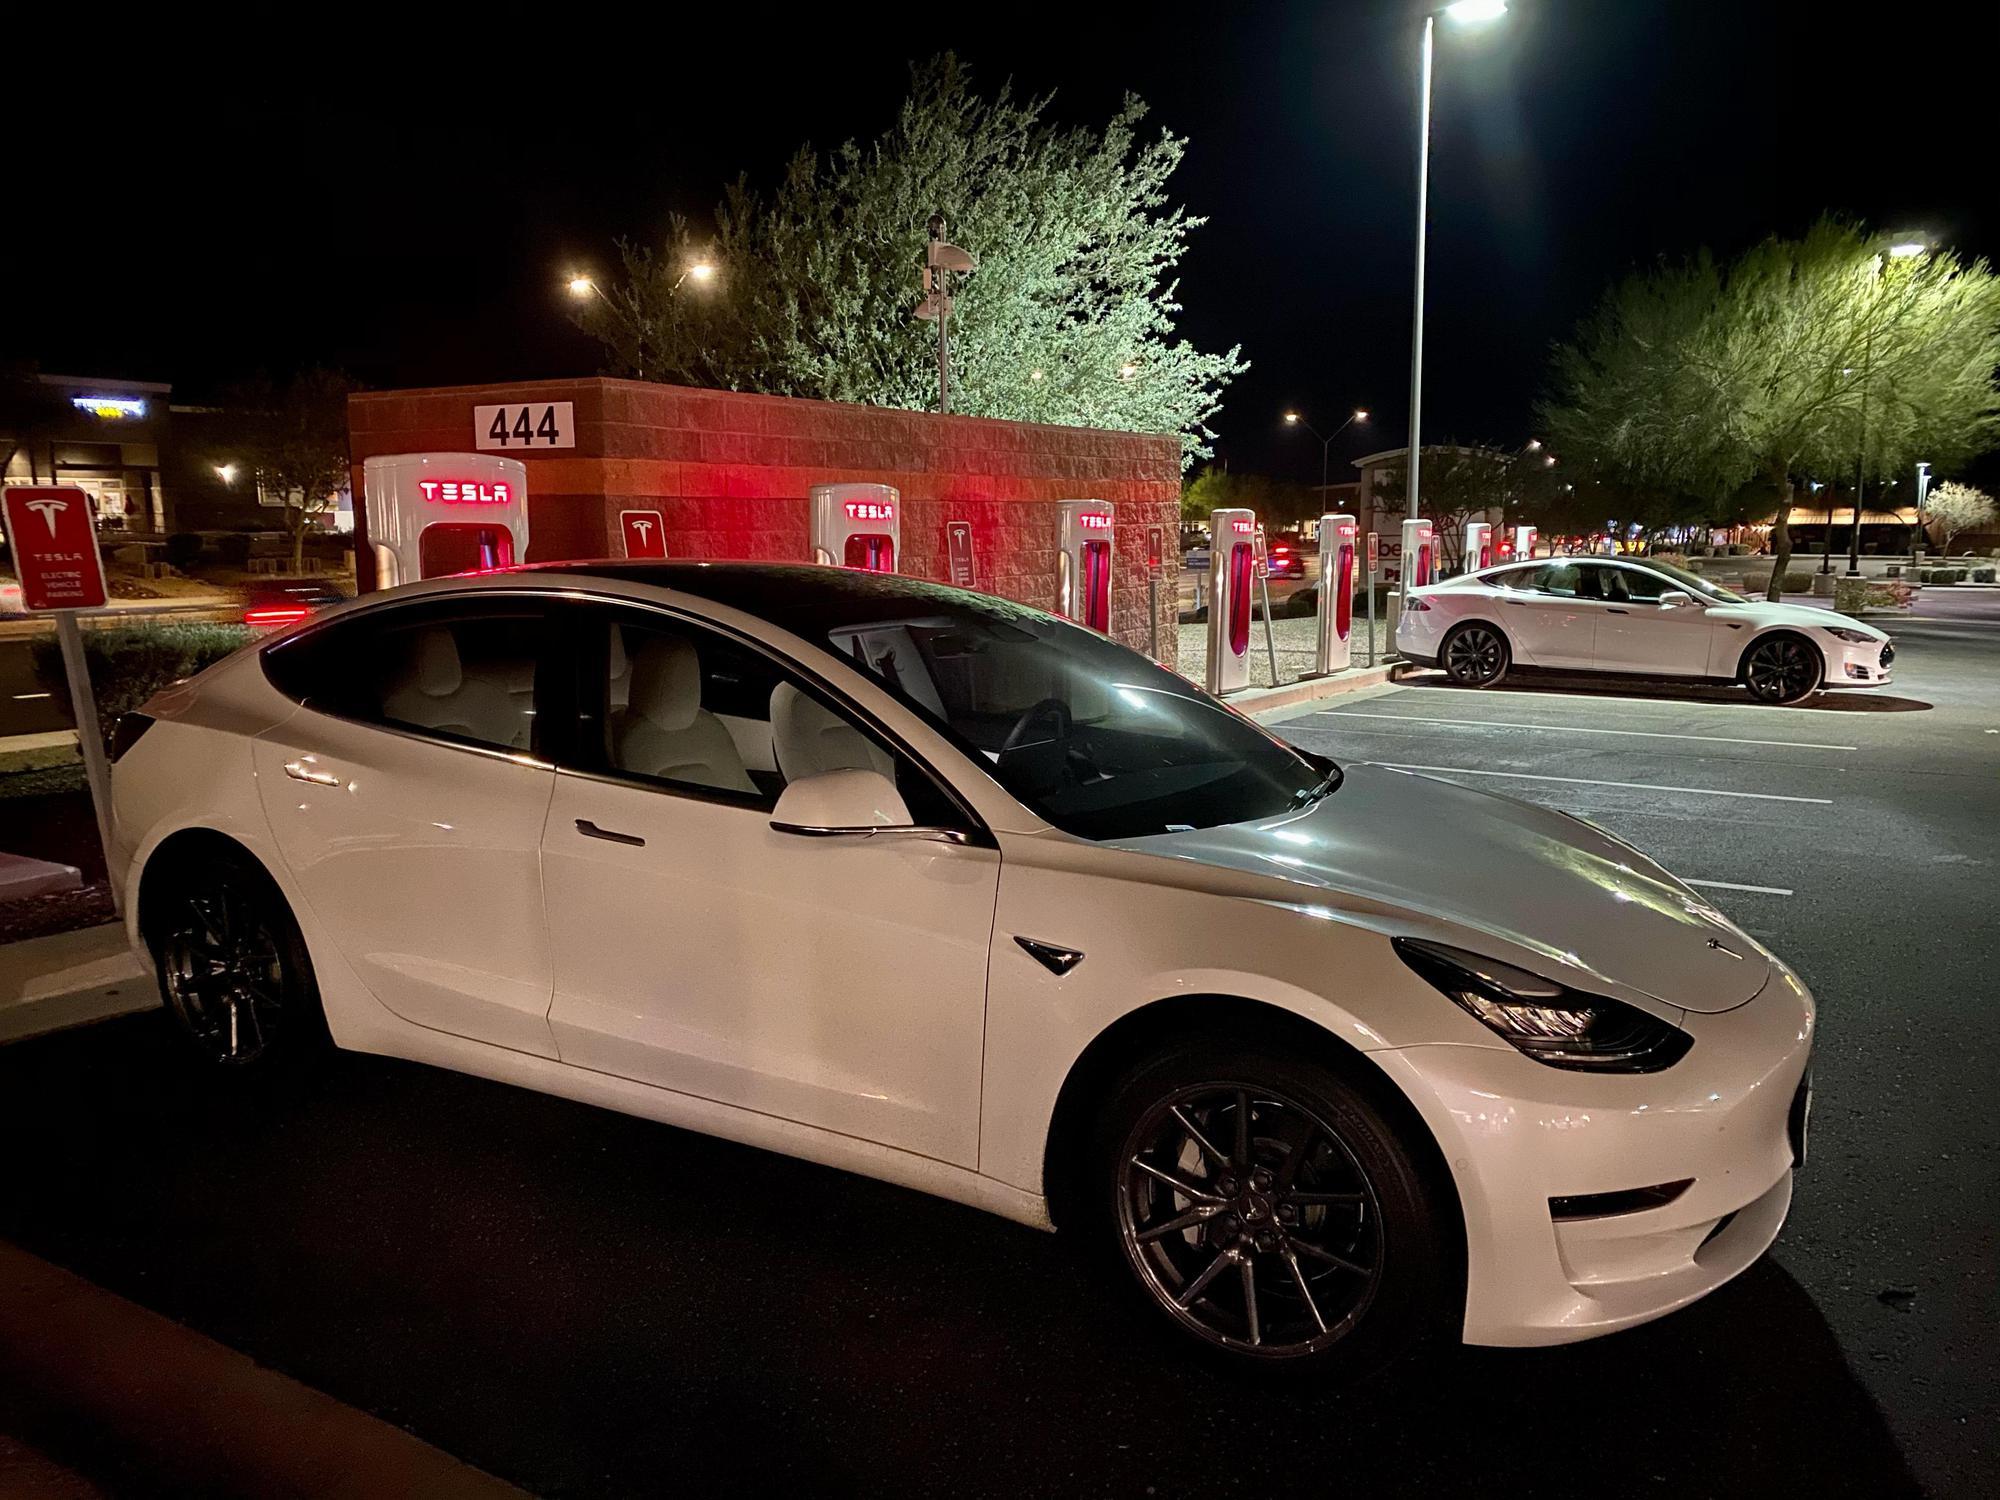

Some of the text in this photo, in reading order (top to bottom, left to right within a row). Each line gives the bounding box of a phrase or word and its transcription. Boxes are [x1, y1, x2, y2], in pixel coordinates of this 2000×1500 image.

[489, 405, 560, 446] 444
[420, 482, 508, 502] TESLA
[845, 504, 893, 519] TESLA
[1081, 516, 1112, 528] TESLA
[33, 552, 83, 561] TESLA
[41, 571, 81, 579] ELECTRIC
